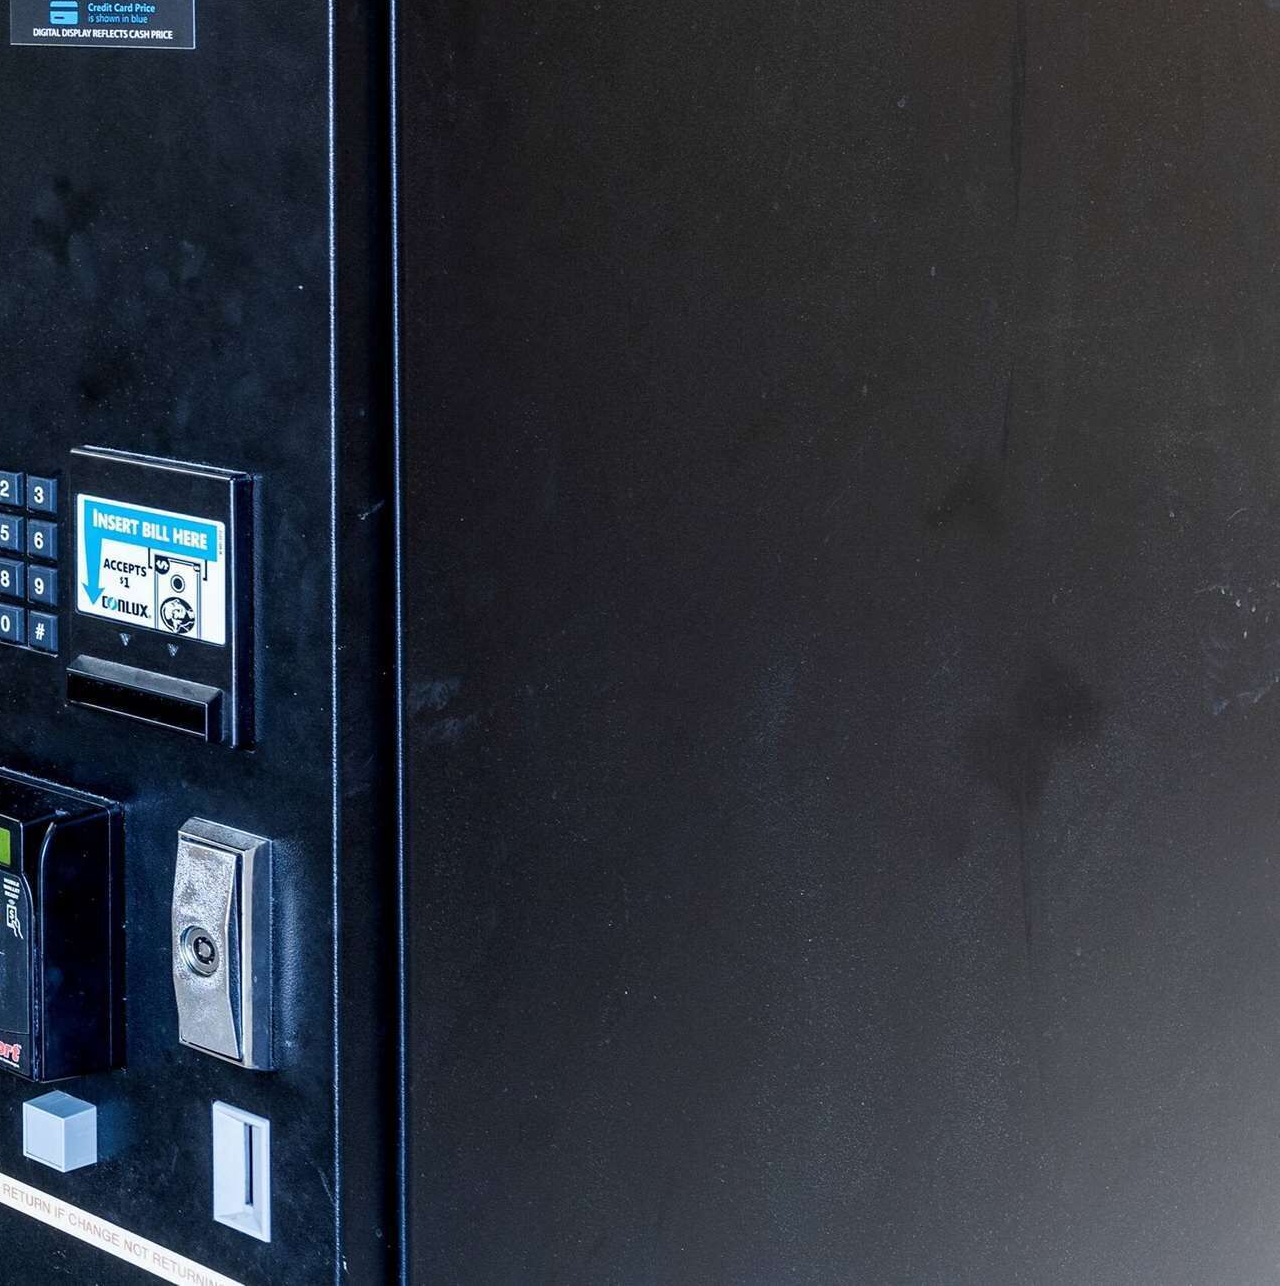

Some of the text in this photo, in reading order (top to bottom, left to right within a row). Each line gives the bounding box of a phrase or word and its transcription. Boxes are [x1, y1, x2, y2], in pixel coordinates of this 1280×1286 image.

[88, 3, 155, 13] Credit Card Price
[88, 14, 148, 24] is shown in blue
[33, 28, 173, 39] DIGITAL DISPLAY REFLECTS CASH PRICE
[0, 480, 10, 497] 2
[34, 486, 44, 504] 3
[0, 524, 10, 542] 5
[34, 532, 44, 550] 6
[92, 508, 140, 534] INSERT
[142, 521, 170, 542] BILL
[173, 529, 208, 551] HERE
[103, 558, 147, 577] ACCEPTS
[0, 570, 10, 588] 8
[34, 577, 44, 595] 9
[119, 576, 130, 589] $1
[102, 595, 149, 619] CONLUX
[0, 616, 11, 632] 0
[2, 1182, 51, 1216] RETURN
[53, 1206, 66, 1221] IF
[68, 1212, 120, 1248] CHANGE
[124, 1238, 149, 1258] NOT
